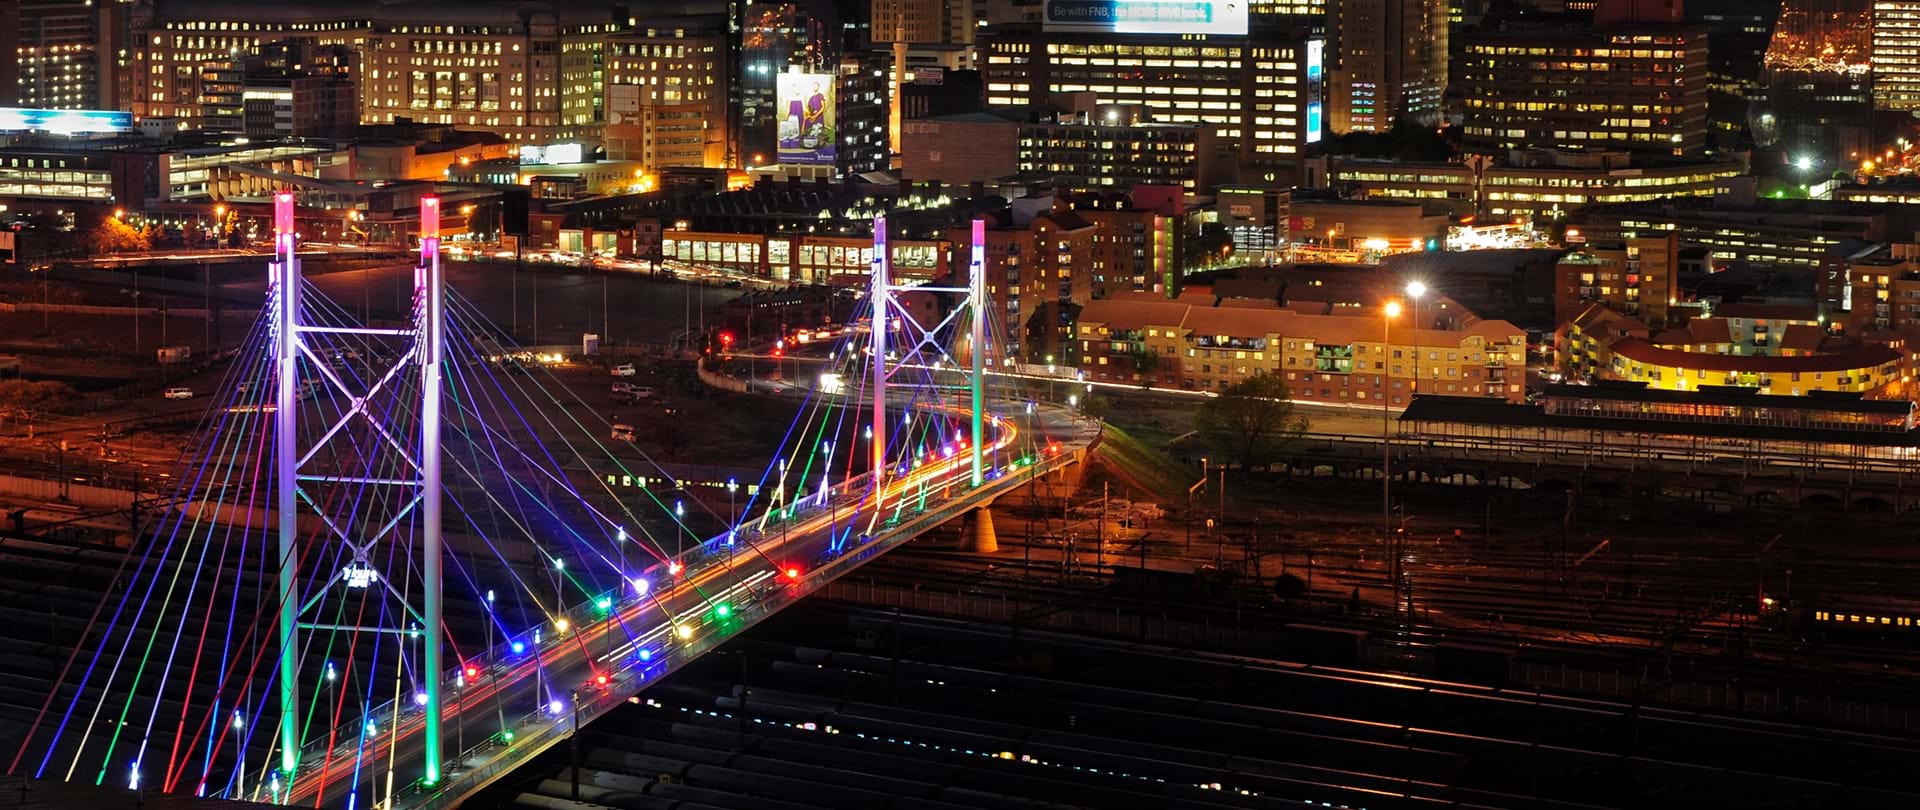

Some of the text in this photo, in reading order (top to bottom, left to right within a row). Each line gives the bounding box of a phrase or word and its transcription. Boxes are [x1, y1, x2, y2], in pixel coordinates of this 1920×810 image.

[1055, 7, 1066, 16] Be
[1067, 7, 1087, 16] with
[1089, 7, 1110, 17] FNB,
[1112, 7, 1127, 17] the
